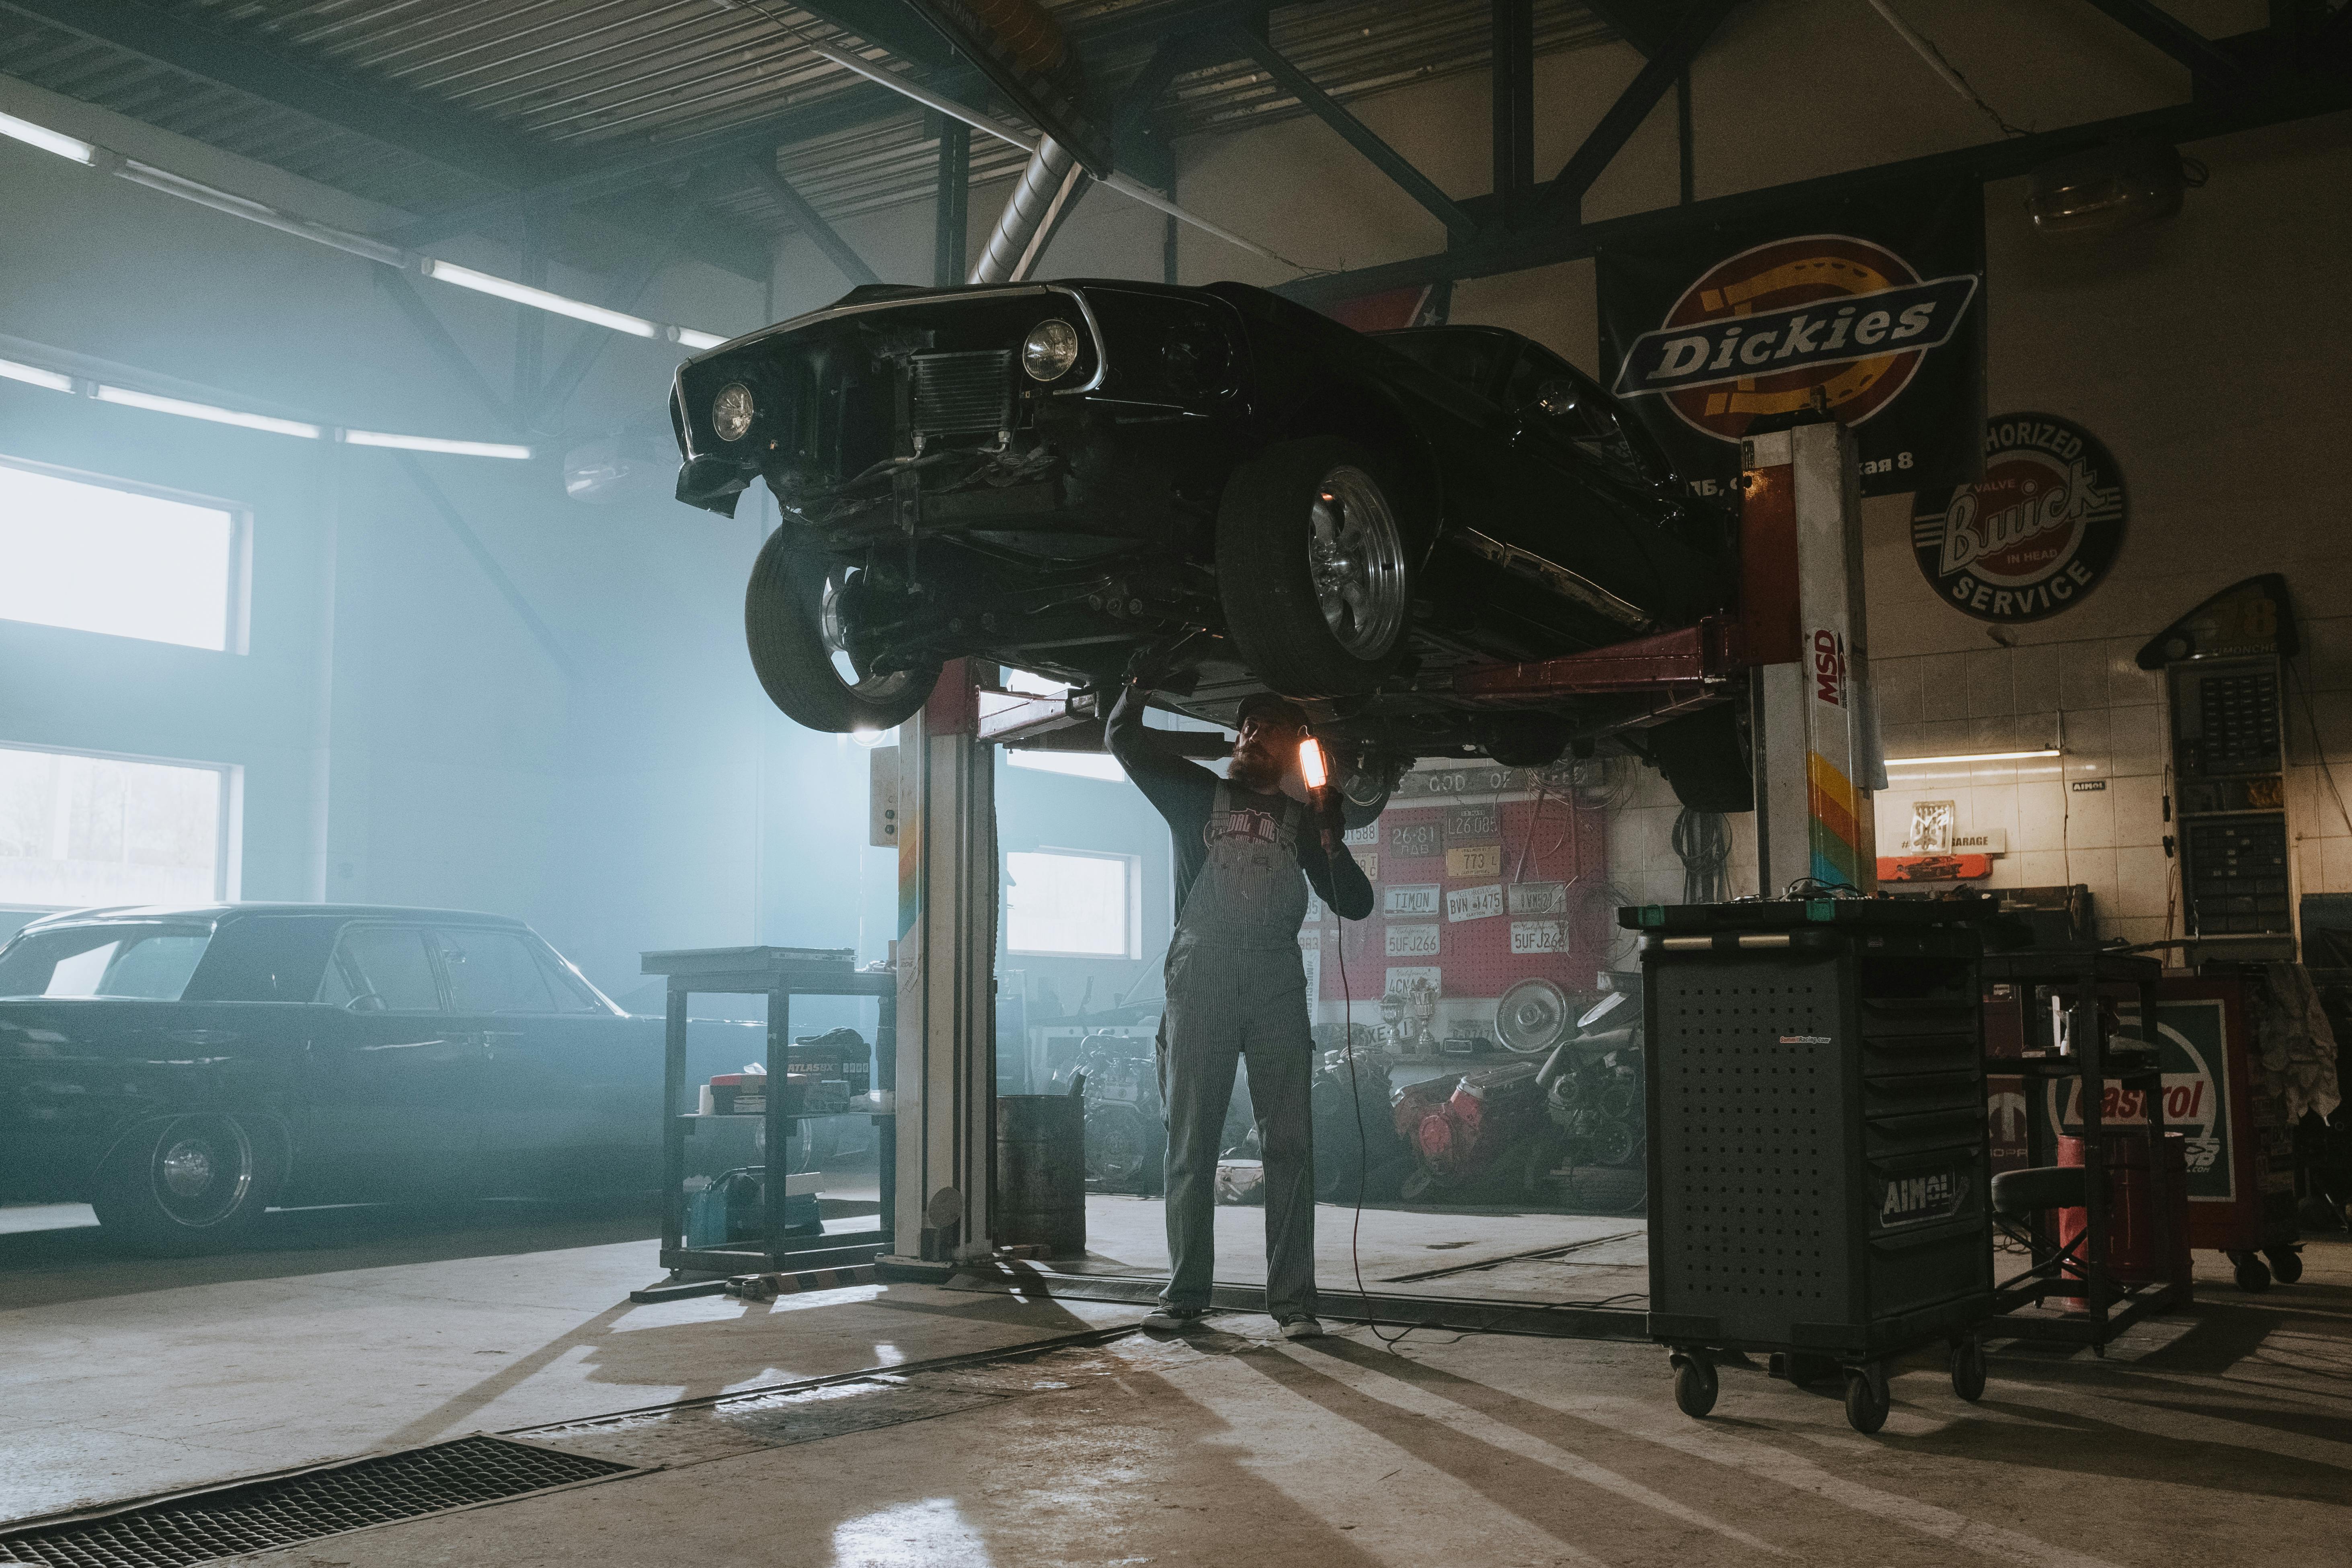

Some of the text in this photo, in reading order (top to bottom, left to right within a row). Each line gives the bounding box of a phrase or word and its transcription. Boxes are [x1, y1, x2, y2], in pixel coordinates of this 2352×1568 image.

[1646, 300, 1937, 380] Dickies
[1987, 422, 2083, 460] HORIZED
[1897, 451, 1914, 469] 8
[1974, 478, 2016, 493] VALVE
[1939, 456, 2109, 578] Buick
[2007, 549, 2057, 564] IN HEAD
[1952, 559, 2093, 615] SERVICE
[1814, 629, 1839, 706] MSD
[1429, 774, 1465, 792] GOD
[1490, 771, 1511, 788] OF
[1463, 853, 1497, 869] 773 L
[1395, 892, 1430, 909] TIMON
[1459, 888, 1490, 898] GEORGIA
[1476, 893, 1500, 910] 1475
[1389, 936, 1436, 952] 5UFJ266
[1990, 1148, 2028, 1158] OPA
[1883, 1174, 1952, 1215] AIMOL
